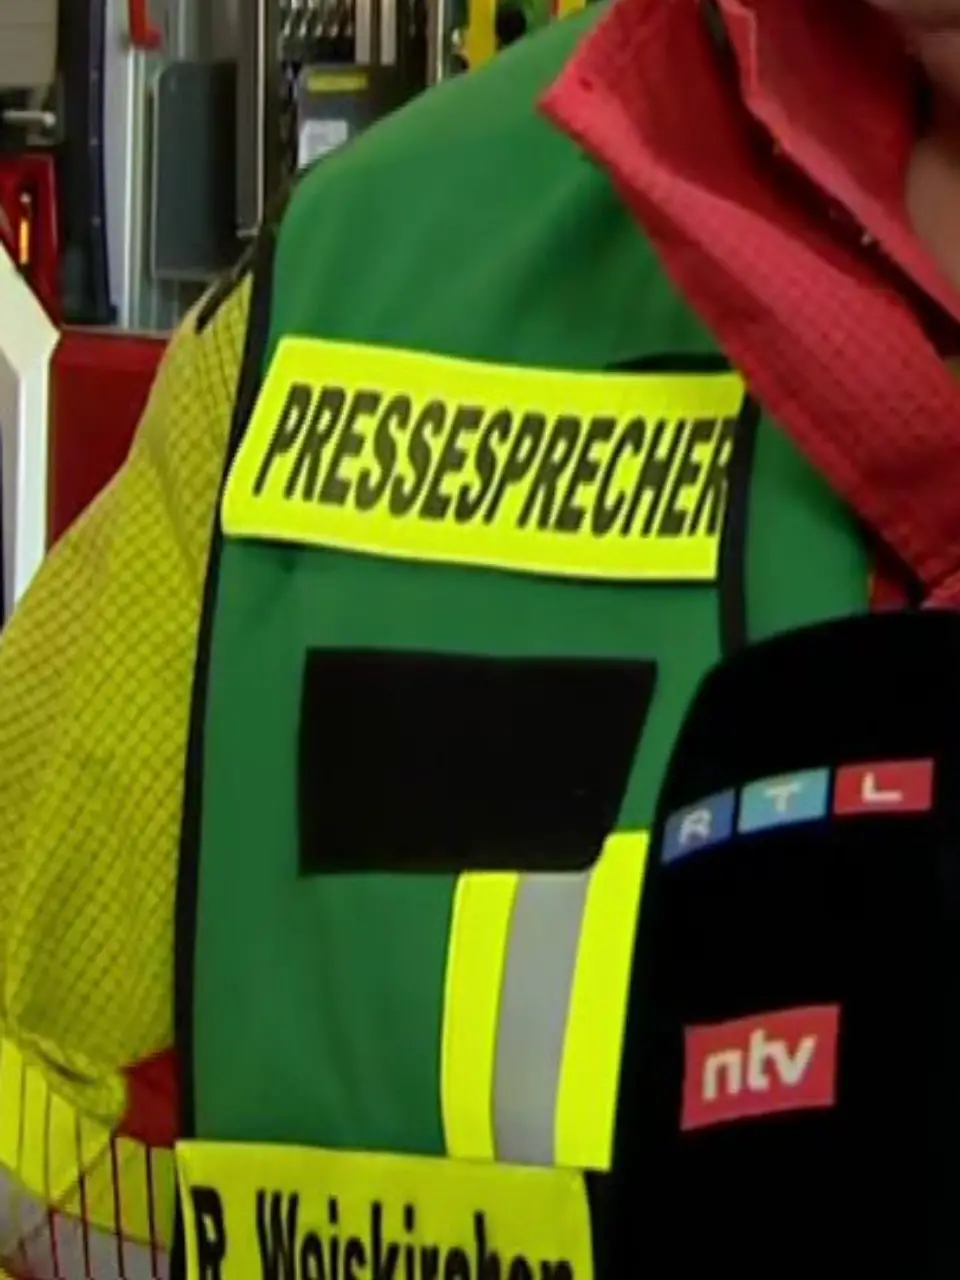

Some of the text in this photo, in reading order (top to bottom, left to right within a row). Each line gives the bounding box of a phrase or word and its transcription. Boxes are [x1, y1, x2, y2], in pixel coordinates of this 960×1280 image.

[252, 381, 741, 538] PRESSESPRECHER
[679, 771, 903, 846] RTL
[702, 1028, 818, 1103] ntv
[256, 1188, 574, 1280] Weiskih
